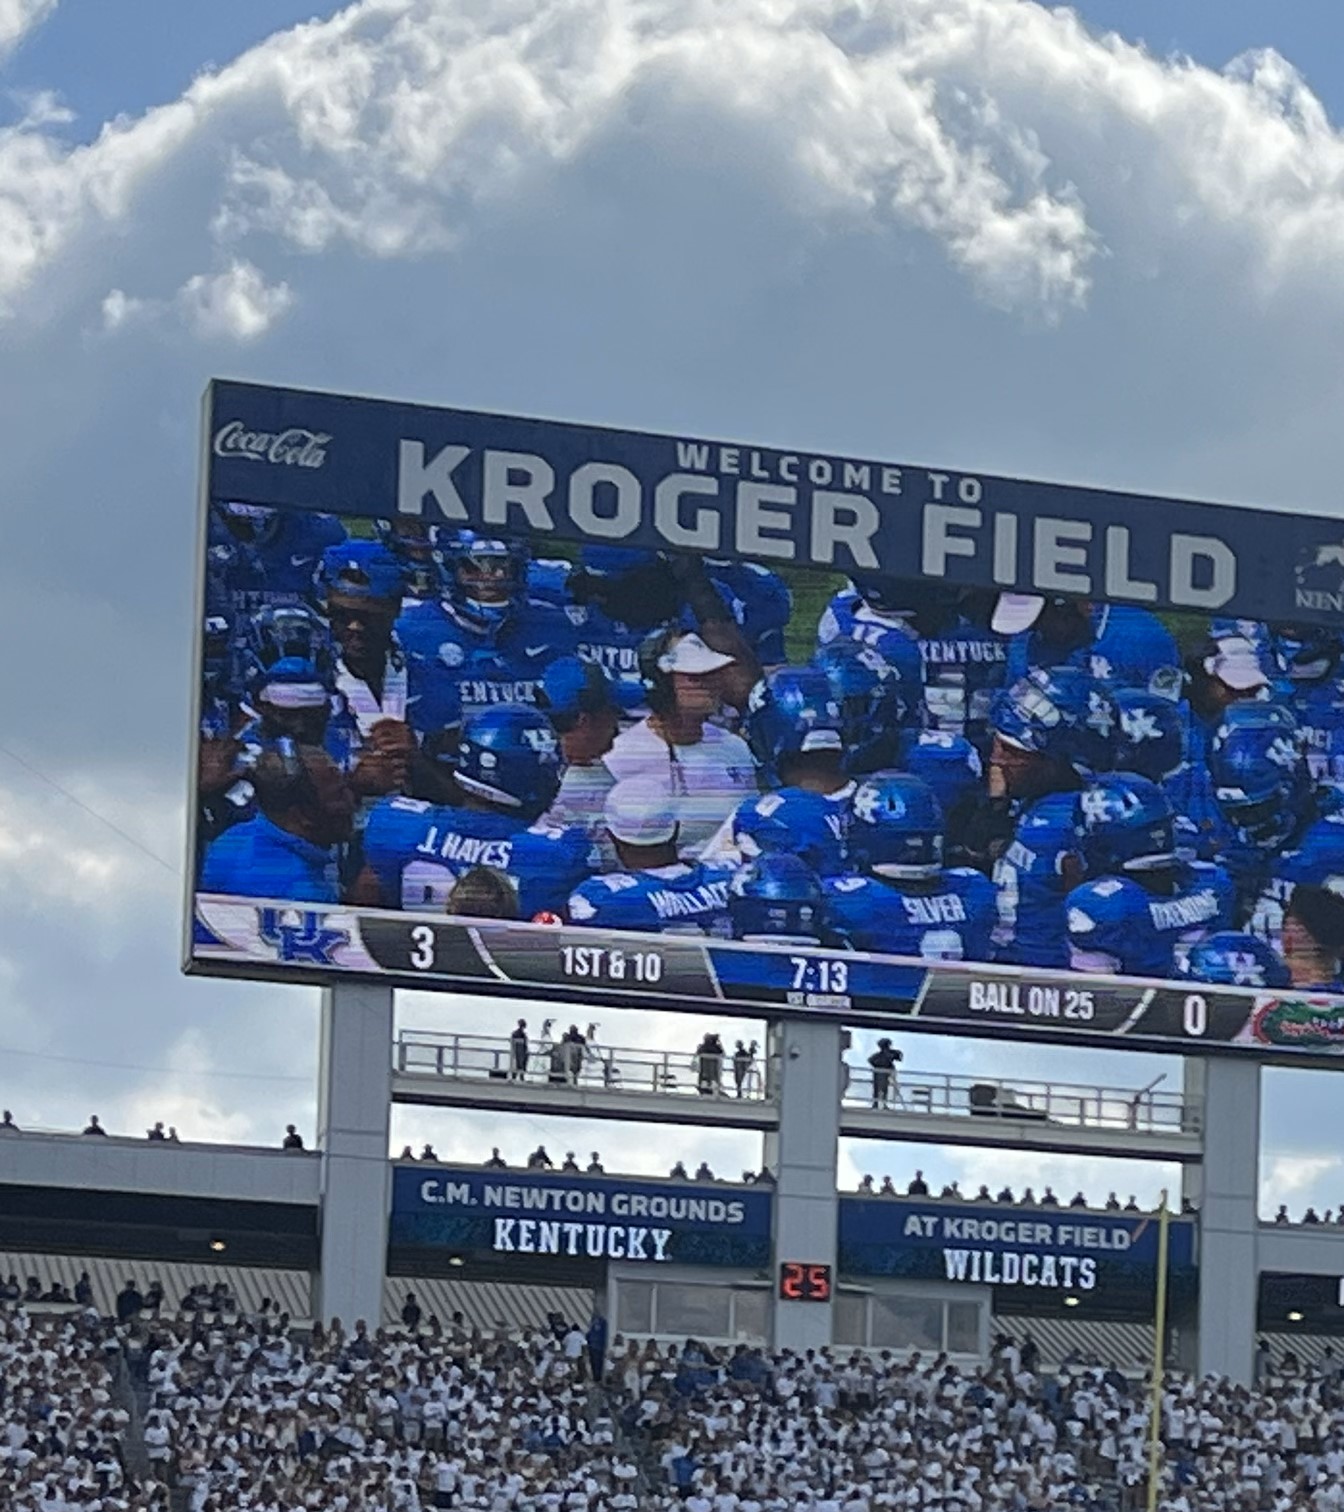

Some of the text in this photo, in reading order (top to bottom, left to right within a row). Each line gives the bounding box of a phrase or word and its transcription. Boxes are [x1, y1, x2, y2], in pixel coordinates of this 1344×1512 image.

[677, 442, 983, 503] WELCOME TO
[398, 438, 1237, 610] KROGER FIELD
[441, 832, 513, 868] HAYES
[902, 893, 967, 924] SILVER
[411, 926, 434, 970] 3
[563, 946, 661, 982] 1ST & 10
[790, 956, 848, 993] 7:13
[969, 981, 1094, 1020] BALL ON 25
[1184, 995, 1206, 1036] 0
[421, 1181, 745, 1224] C.M. NEWTON GROUNDS
[493, 1218, 672, 1260] KENTUCKY
[904, 1215, 1131, 1250] AT KROGER FIELD
[784, 1264, 828, 1298] 25
[943, 1248, 1097, 1290] WILDCATS
